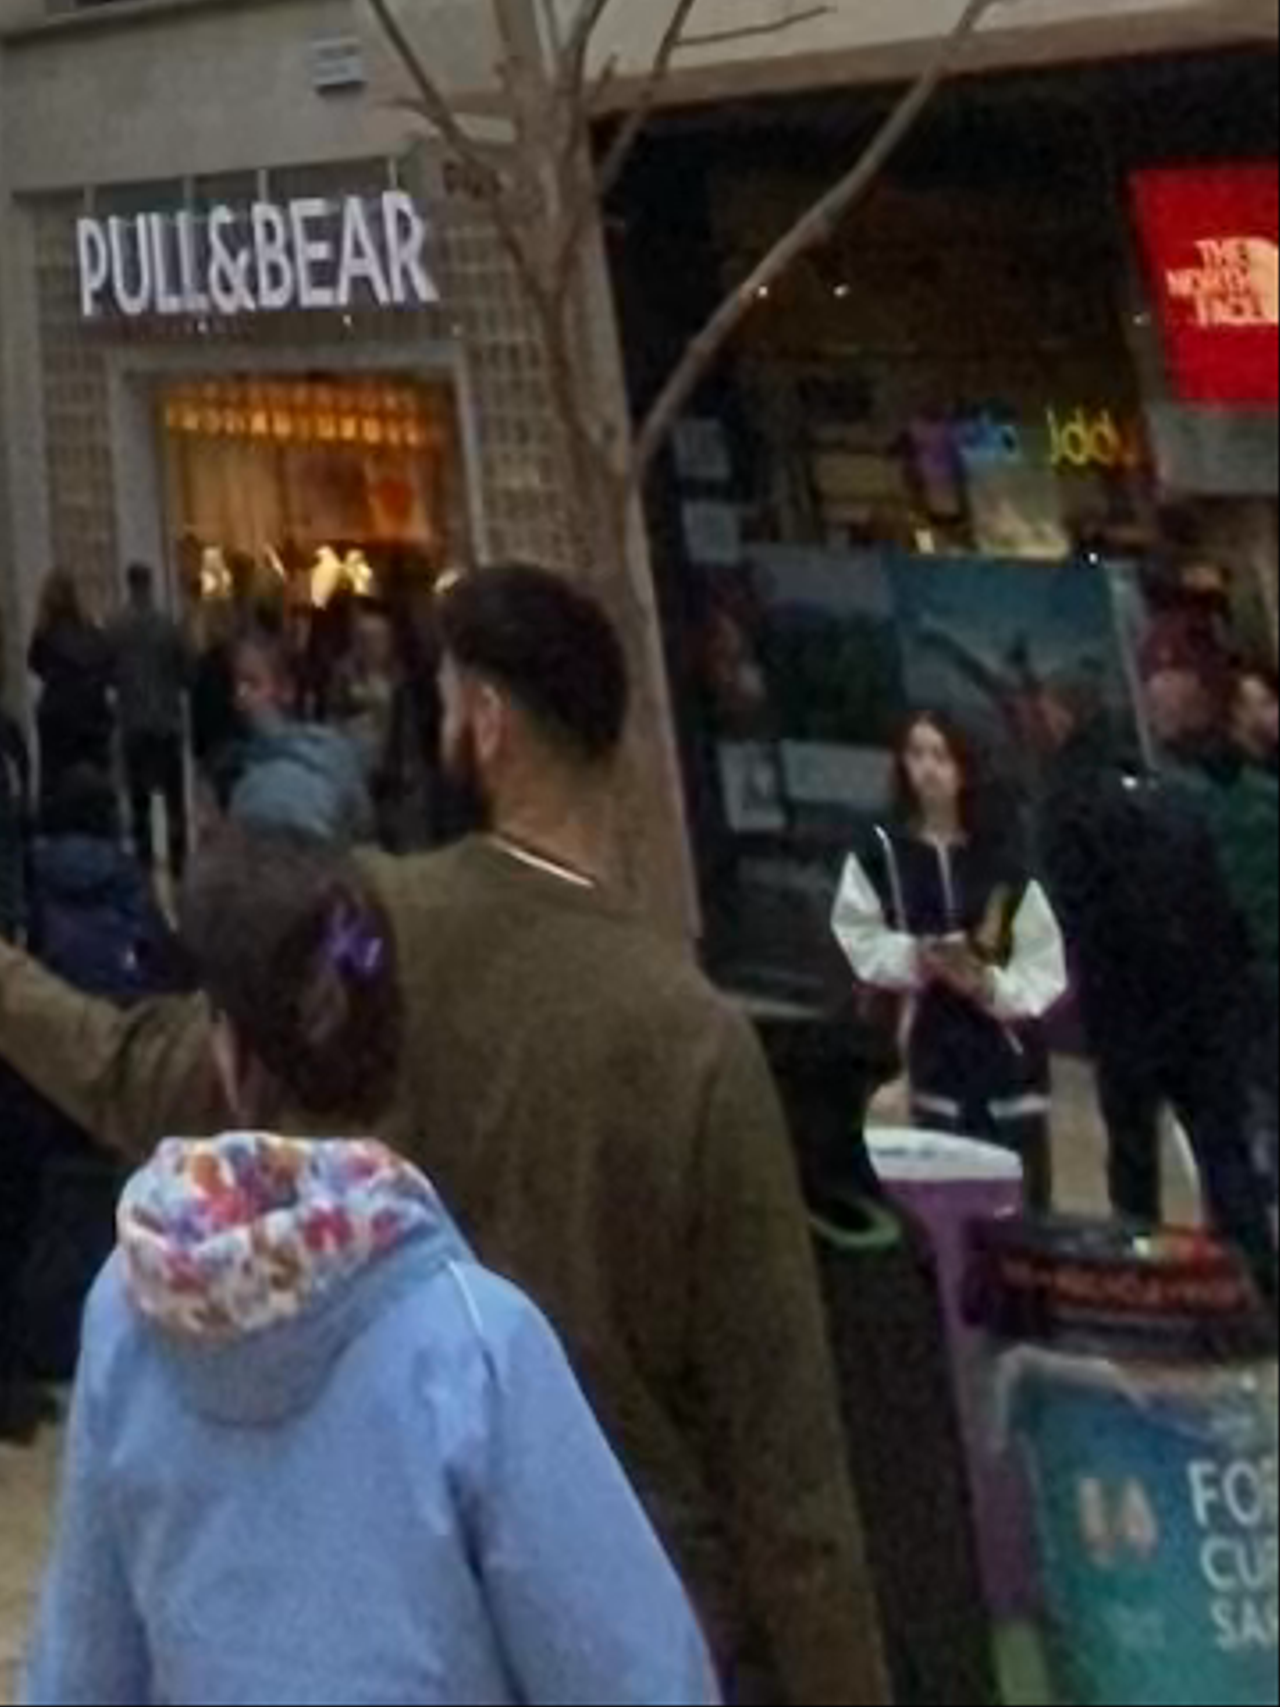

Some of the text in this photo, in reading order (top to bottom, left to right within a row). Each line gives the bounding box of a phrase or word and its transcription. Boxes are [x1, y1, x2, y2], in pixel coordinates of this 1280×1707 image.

[76, 189, 440, 318] PULL&BEAR
[1187, 1459, 1279, 1528] FO
[1200, 1534, 1279, 1593] CU
